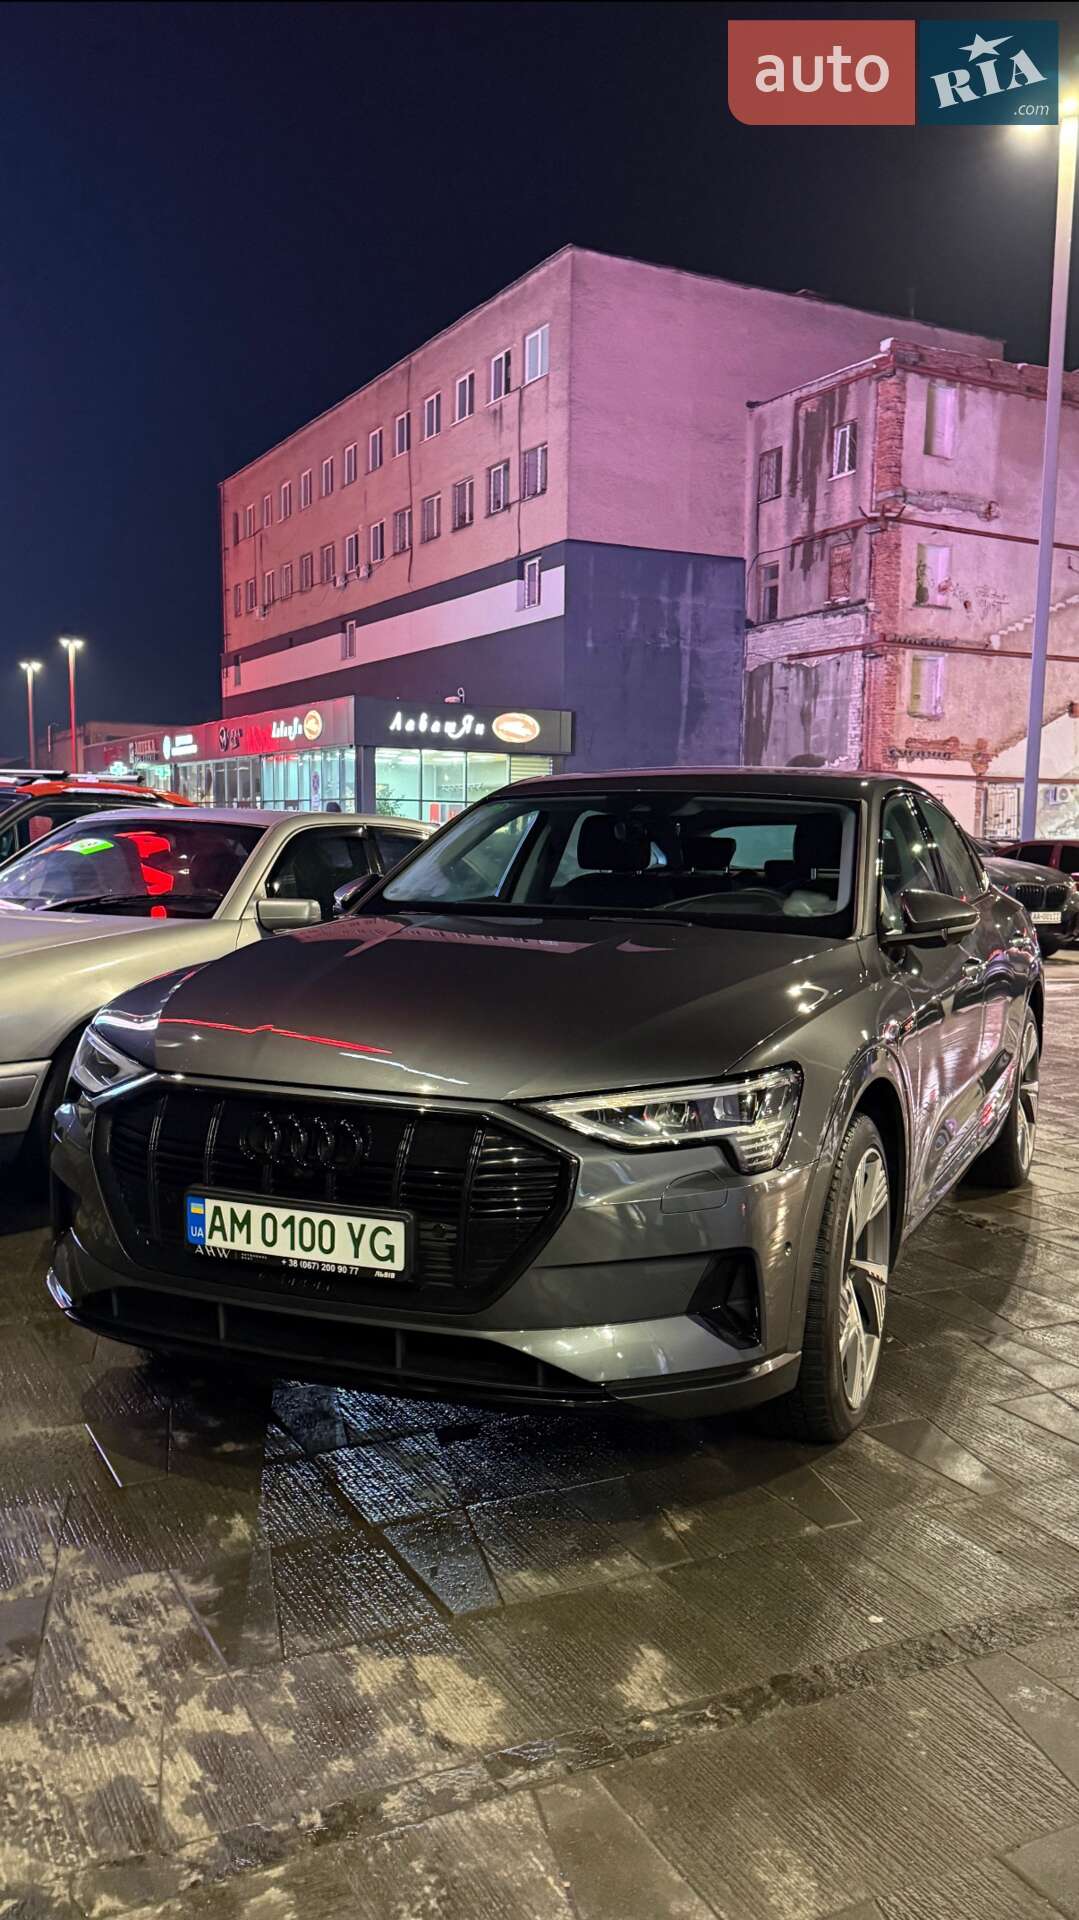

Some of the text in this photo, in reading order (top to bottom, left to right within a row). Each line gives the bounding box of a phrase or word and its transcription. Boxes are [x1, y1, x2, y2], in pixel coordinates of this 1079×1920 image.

[191, 1226, 204, 1238] UA
[208, 1205, 395, 1263] AM 0100 YG
[194, 1245, 231, 1259] AHW
[288, 1259, 298, 1267] 38
[300, 1261, 319, 1270] (067)
[321, 1263, 336, 1272] 200
[337, 1265, 348, 1274] 90
[349, 1267, 359, 1275] 77
